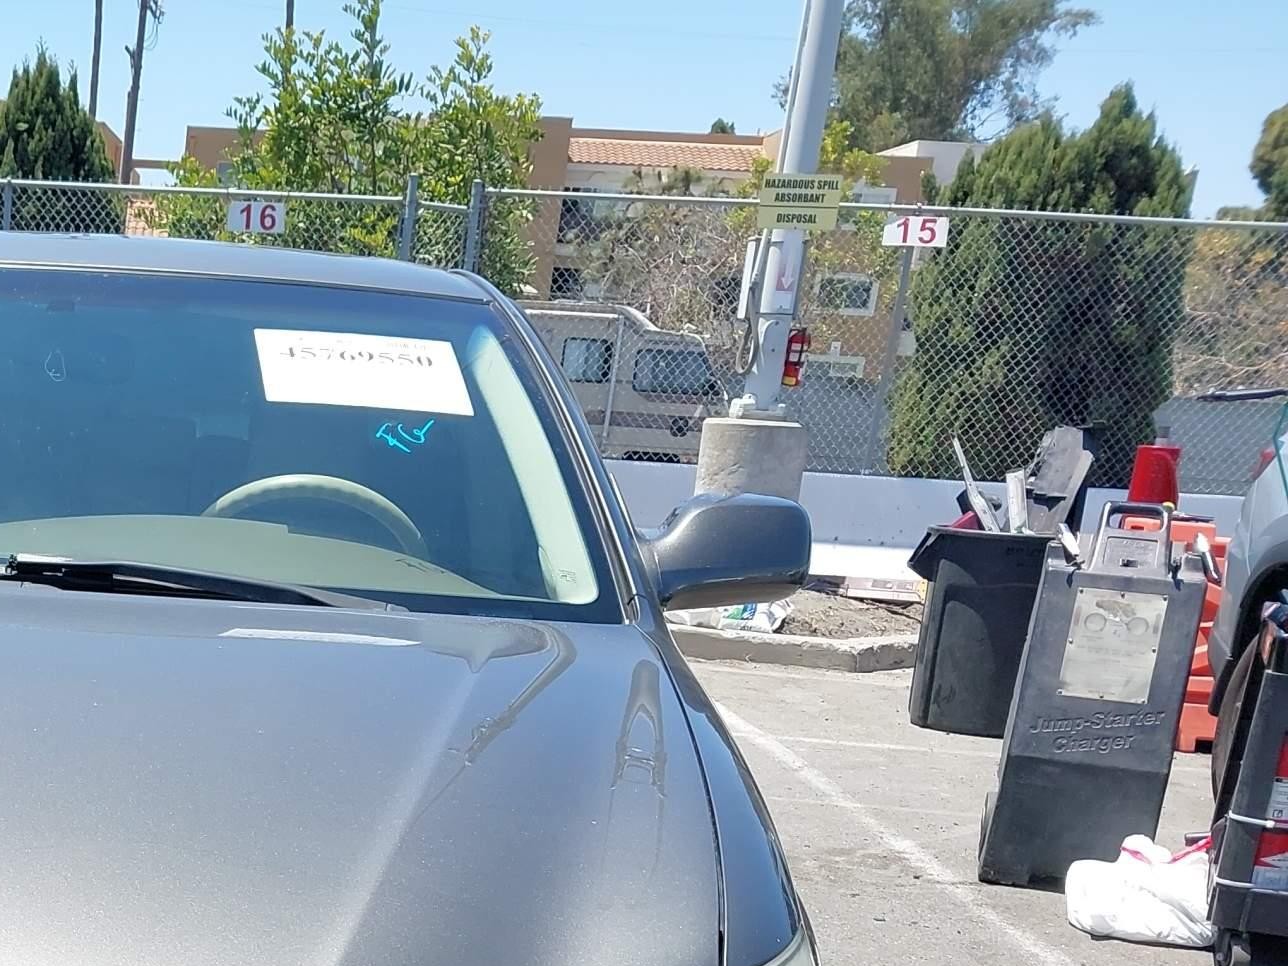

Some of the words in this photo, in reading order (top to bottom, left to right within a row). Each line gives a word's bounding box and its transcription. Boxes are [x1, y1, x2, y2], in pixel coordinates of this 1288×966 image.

[764, 179, 816, 190] HAZARDOUS
[817, 180, 840, 190] SPILL
[774, 192, 826, 204] ABSORBANT
[240, 203, 277, 231] 16
[776, 212, 818, 224] DISPOSAL
[897, 217, 938, 244] 15
[1029, 708, 1166, 734] Jump-Starter
[1052, 735, 1136, 754] Charger
